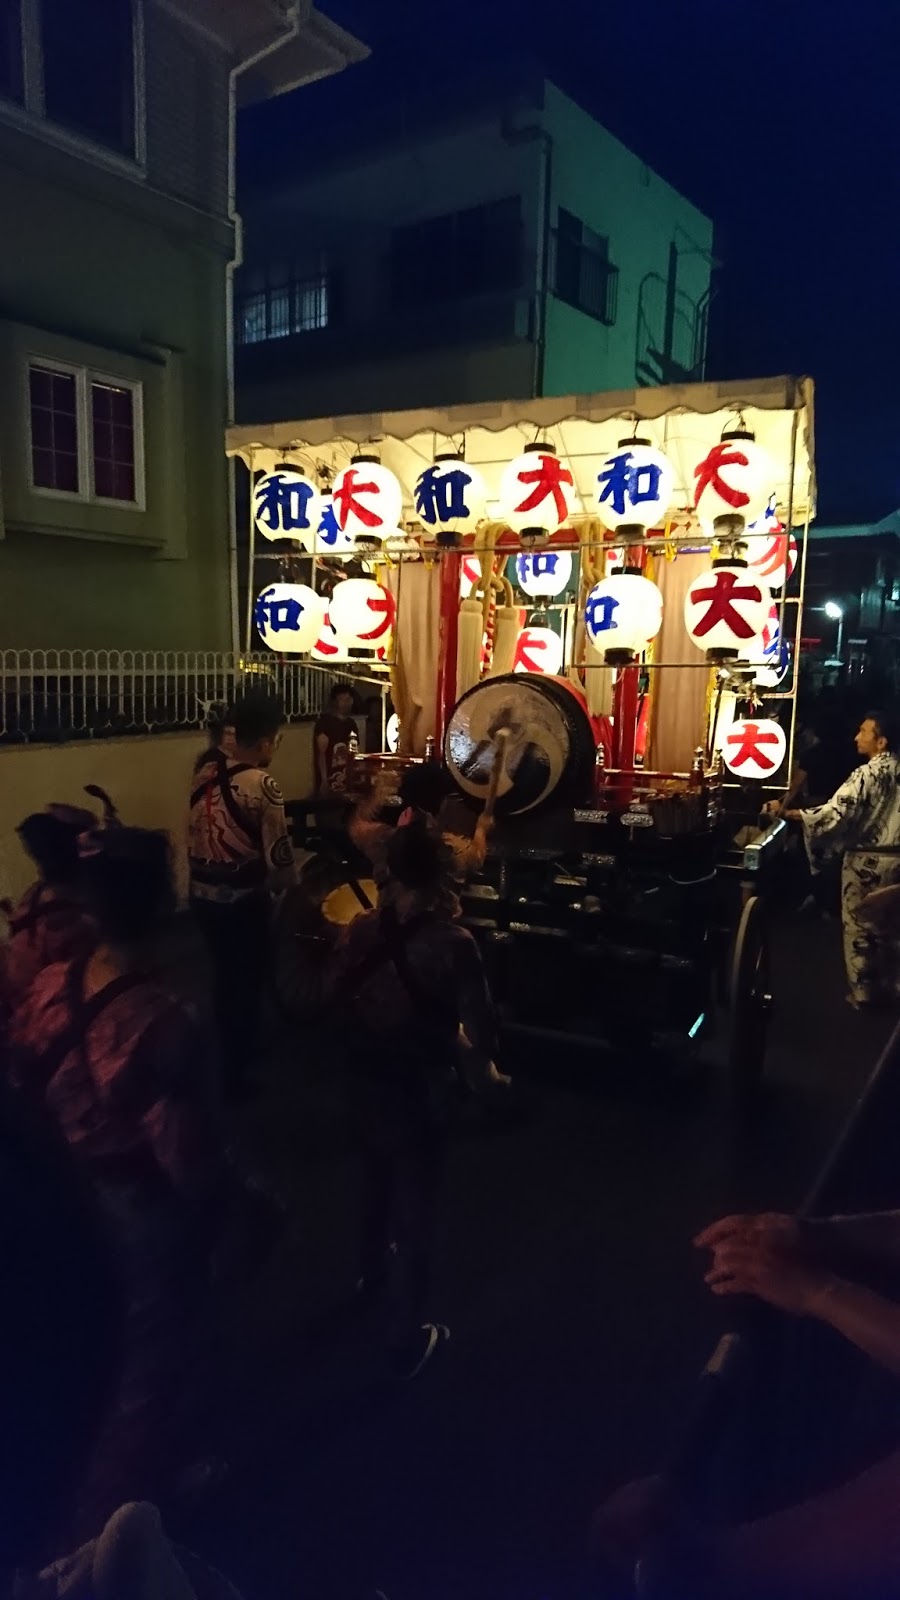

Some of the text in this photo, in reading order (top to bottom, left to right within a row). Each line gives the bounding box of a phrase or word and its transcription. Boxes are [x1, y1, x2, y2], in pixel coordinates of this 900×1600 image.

[255, 474, 314, 530] 和
[333, 470, 384, 531] 大
[414, 466, 472, 525] 和
[514, 455, 574, 523] 大
[598, 452, 663, 516] 和
[694, 443, 750, 509] 大
[255, 588, 305, 637] 和
[690, 571, 764, 639] 大
[727, 723, 779, 770] 大
